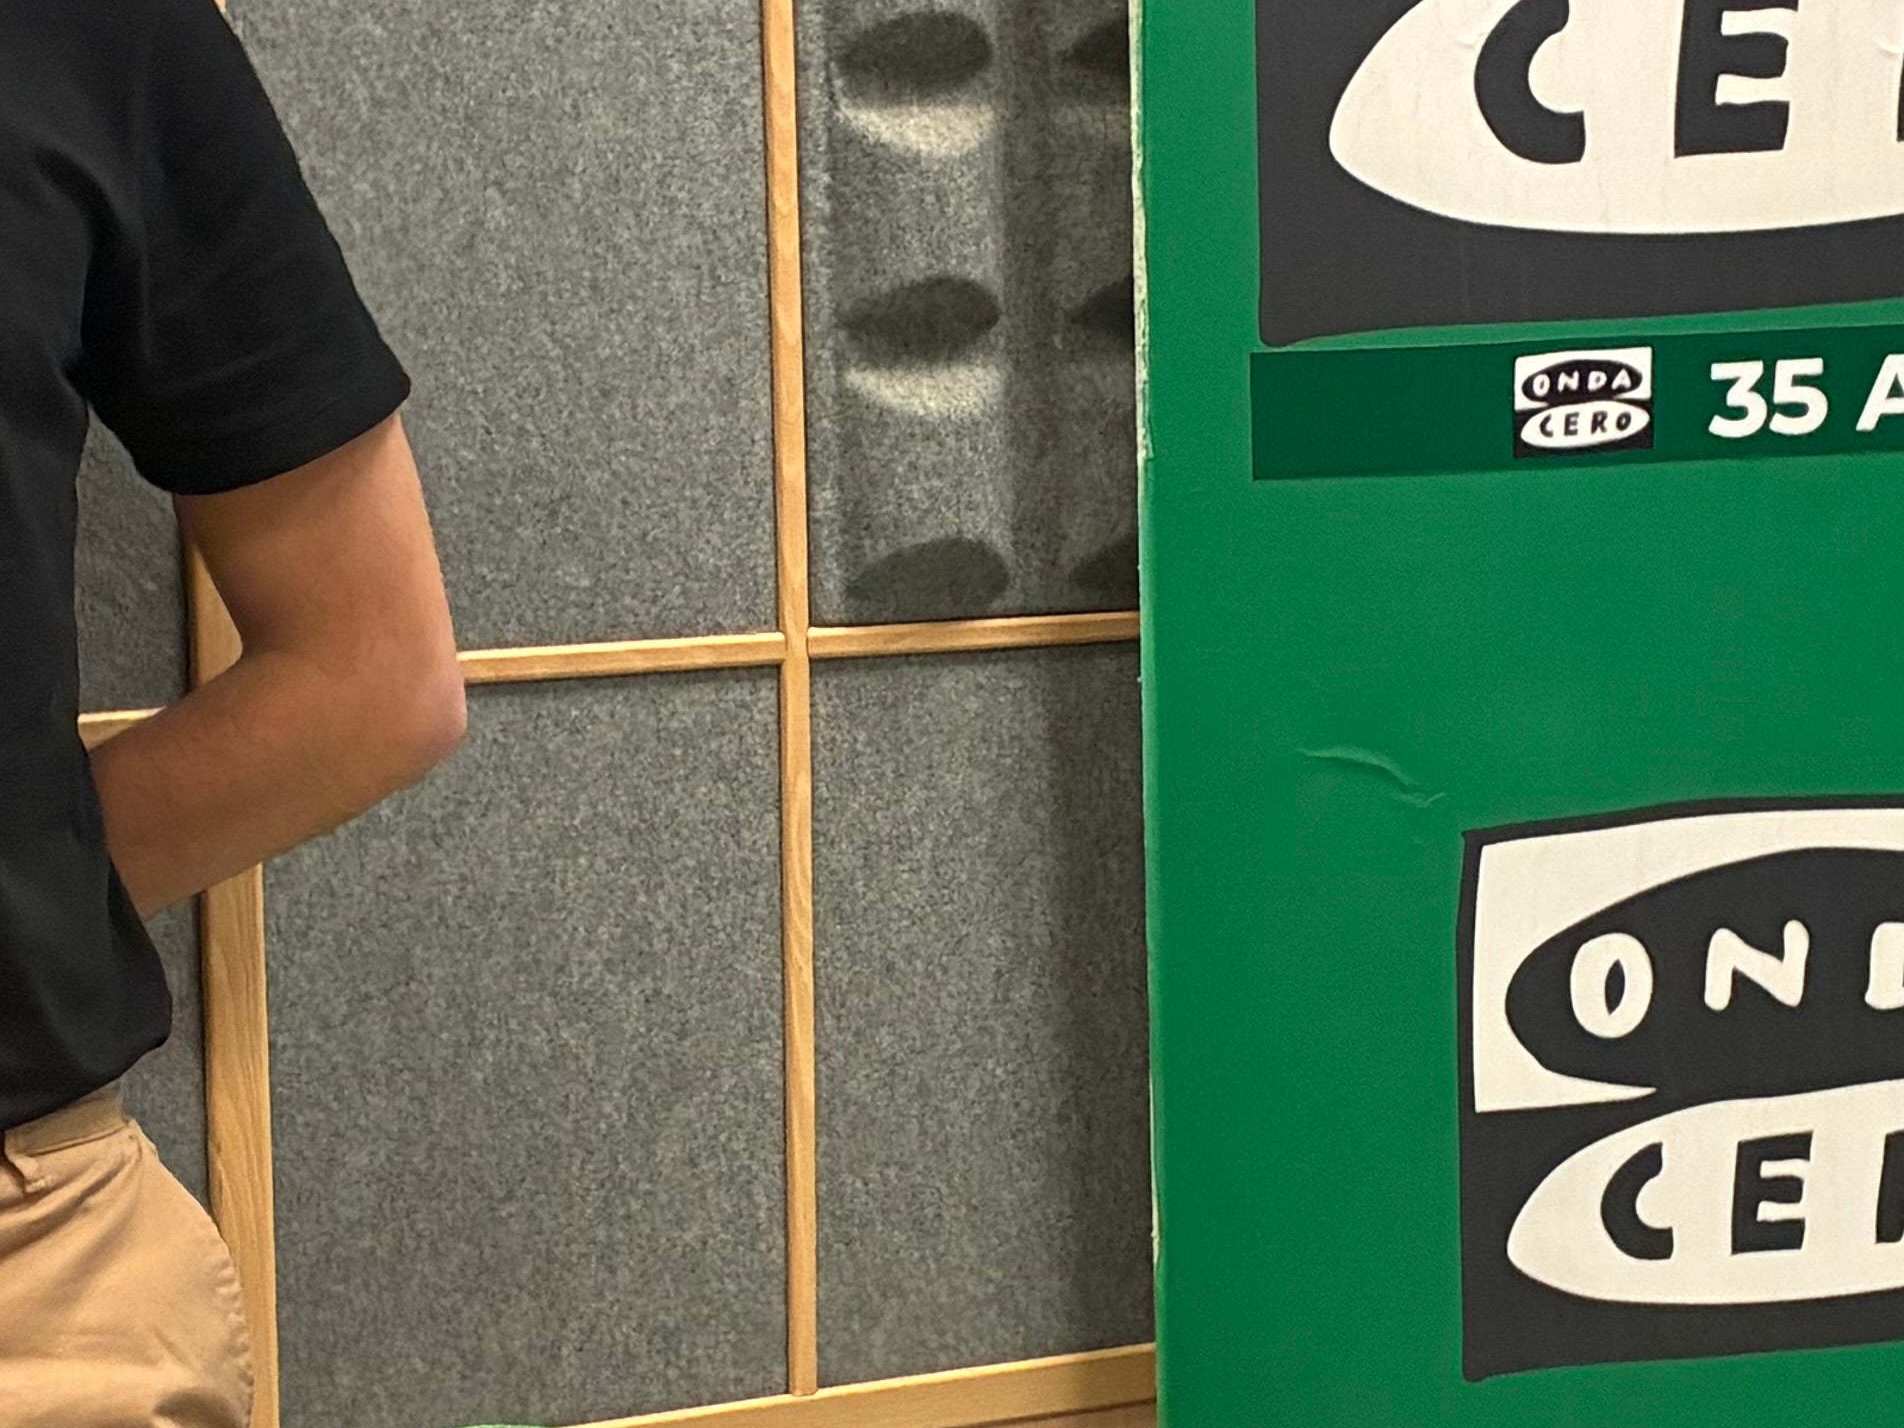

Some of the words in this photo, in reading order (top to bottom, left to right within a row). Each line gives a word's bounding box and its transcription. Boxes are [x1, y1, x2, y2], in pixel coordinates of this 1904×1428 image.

[1532, 367, 1632, 398] ONDA
[1707, 357, 1828, 439] 35
[1538, 410, 1632, 438] CERO
